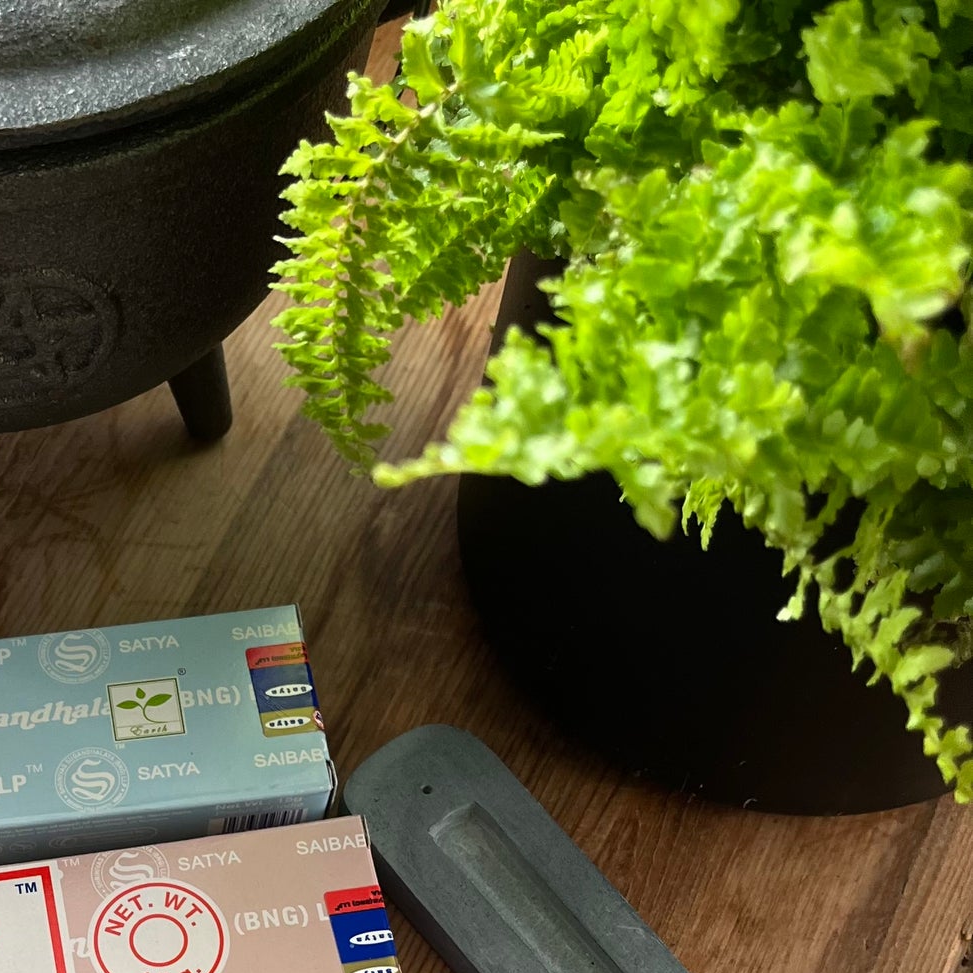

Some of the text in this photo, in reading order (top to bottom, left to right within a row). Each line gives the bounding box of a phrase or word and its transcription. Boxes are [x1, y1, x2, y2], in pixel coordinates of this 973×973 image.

[118, 634, 180, 653] SATYA
[137, 761, 200, 781] SATYA
[178, 850, 241, 871] SATYA
[234, 904, 308, 935] (BNG)
